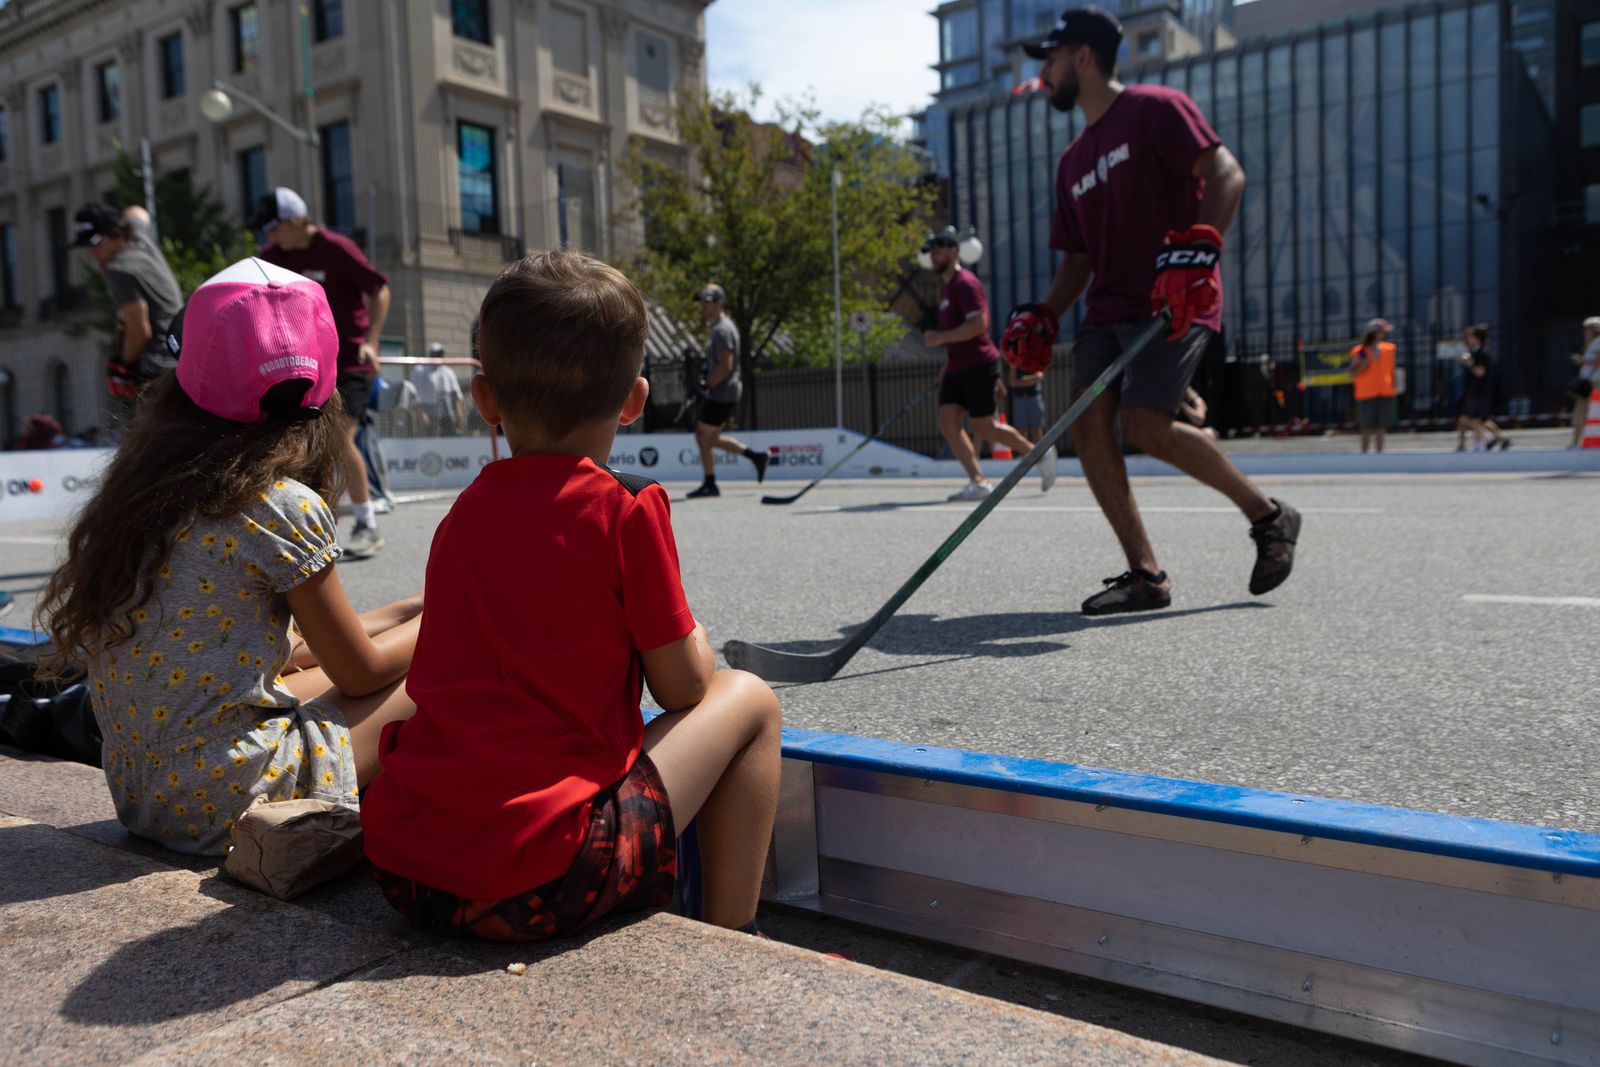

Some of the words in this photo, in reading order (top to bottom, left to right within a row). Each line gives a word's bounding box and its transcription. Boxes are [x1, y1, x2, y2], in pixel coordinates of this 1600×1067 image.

[1156, 250, 1216, 269] CCM
[678, 447, 739, 466] Caada
[780, 453, 824, 467] FORCE
[387, 458, 418, 472] PLAY
